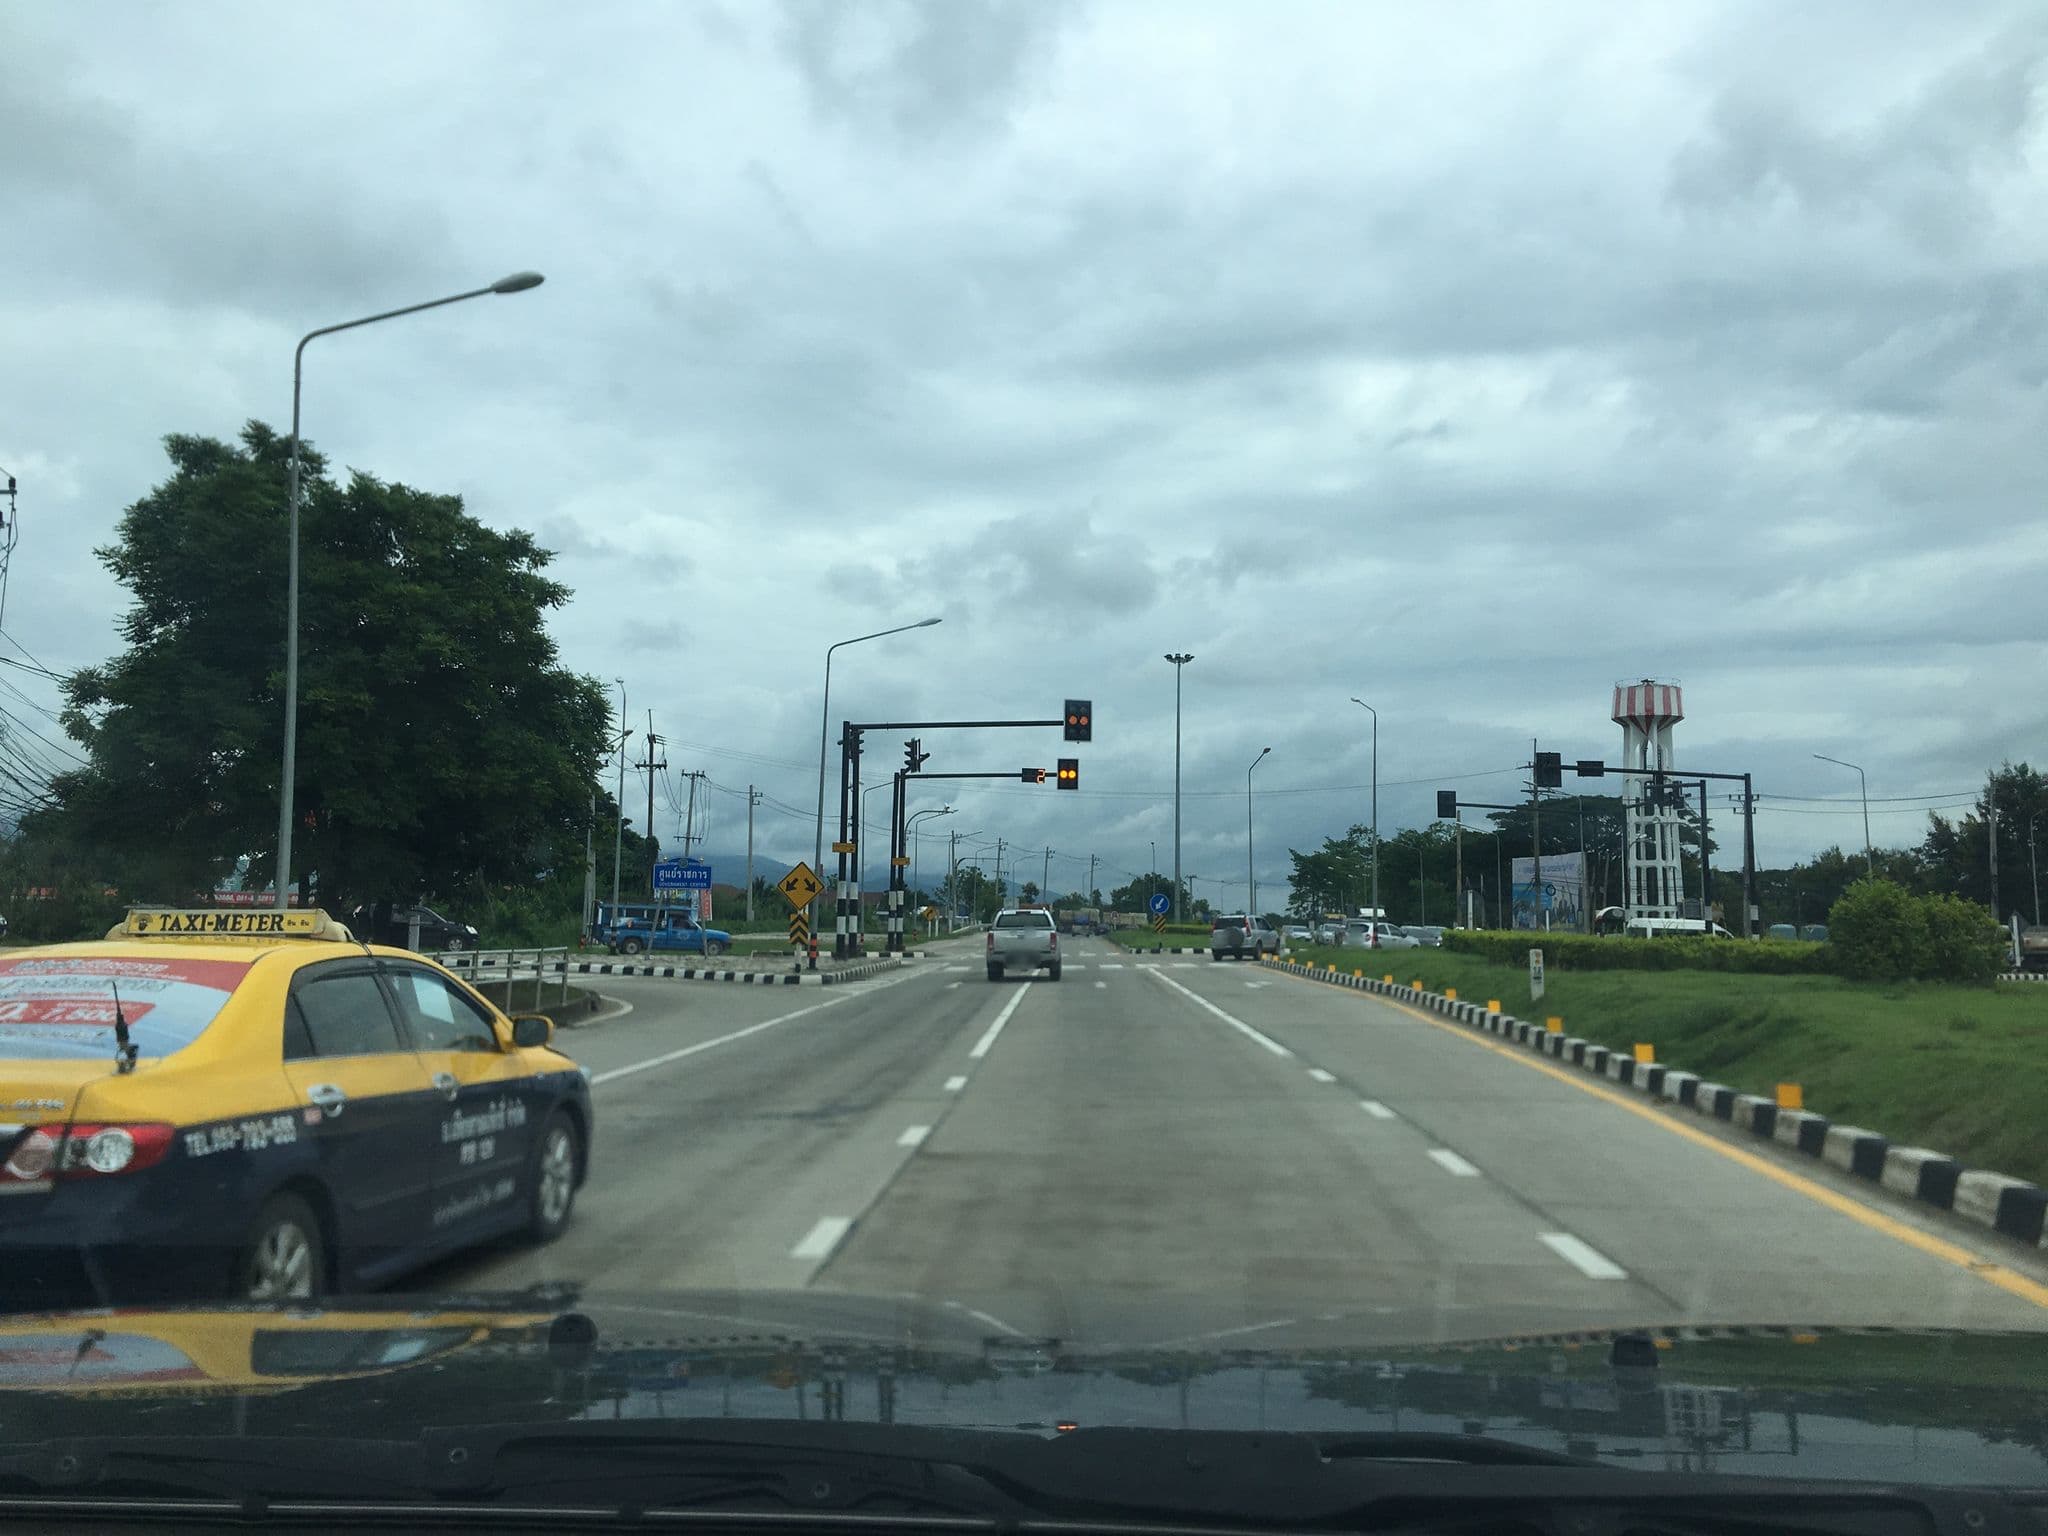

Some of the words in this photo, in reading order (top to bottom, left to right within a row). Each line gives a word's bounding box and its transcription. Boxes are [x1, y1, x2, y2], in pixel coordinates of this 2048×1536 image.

[1037, 769, 1045, 784] 2
[659, 867, 708, 881] ศูนย์ราชการ
[159, 913, 285, 932] TAXI-METER
